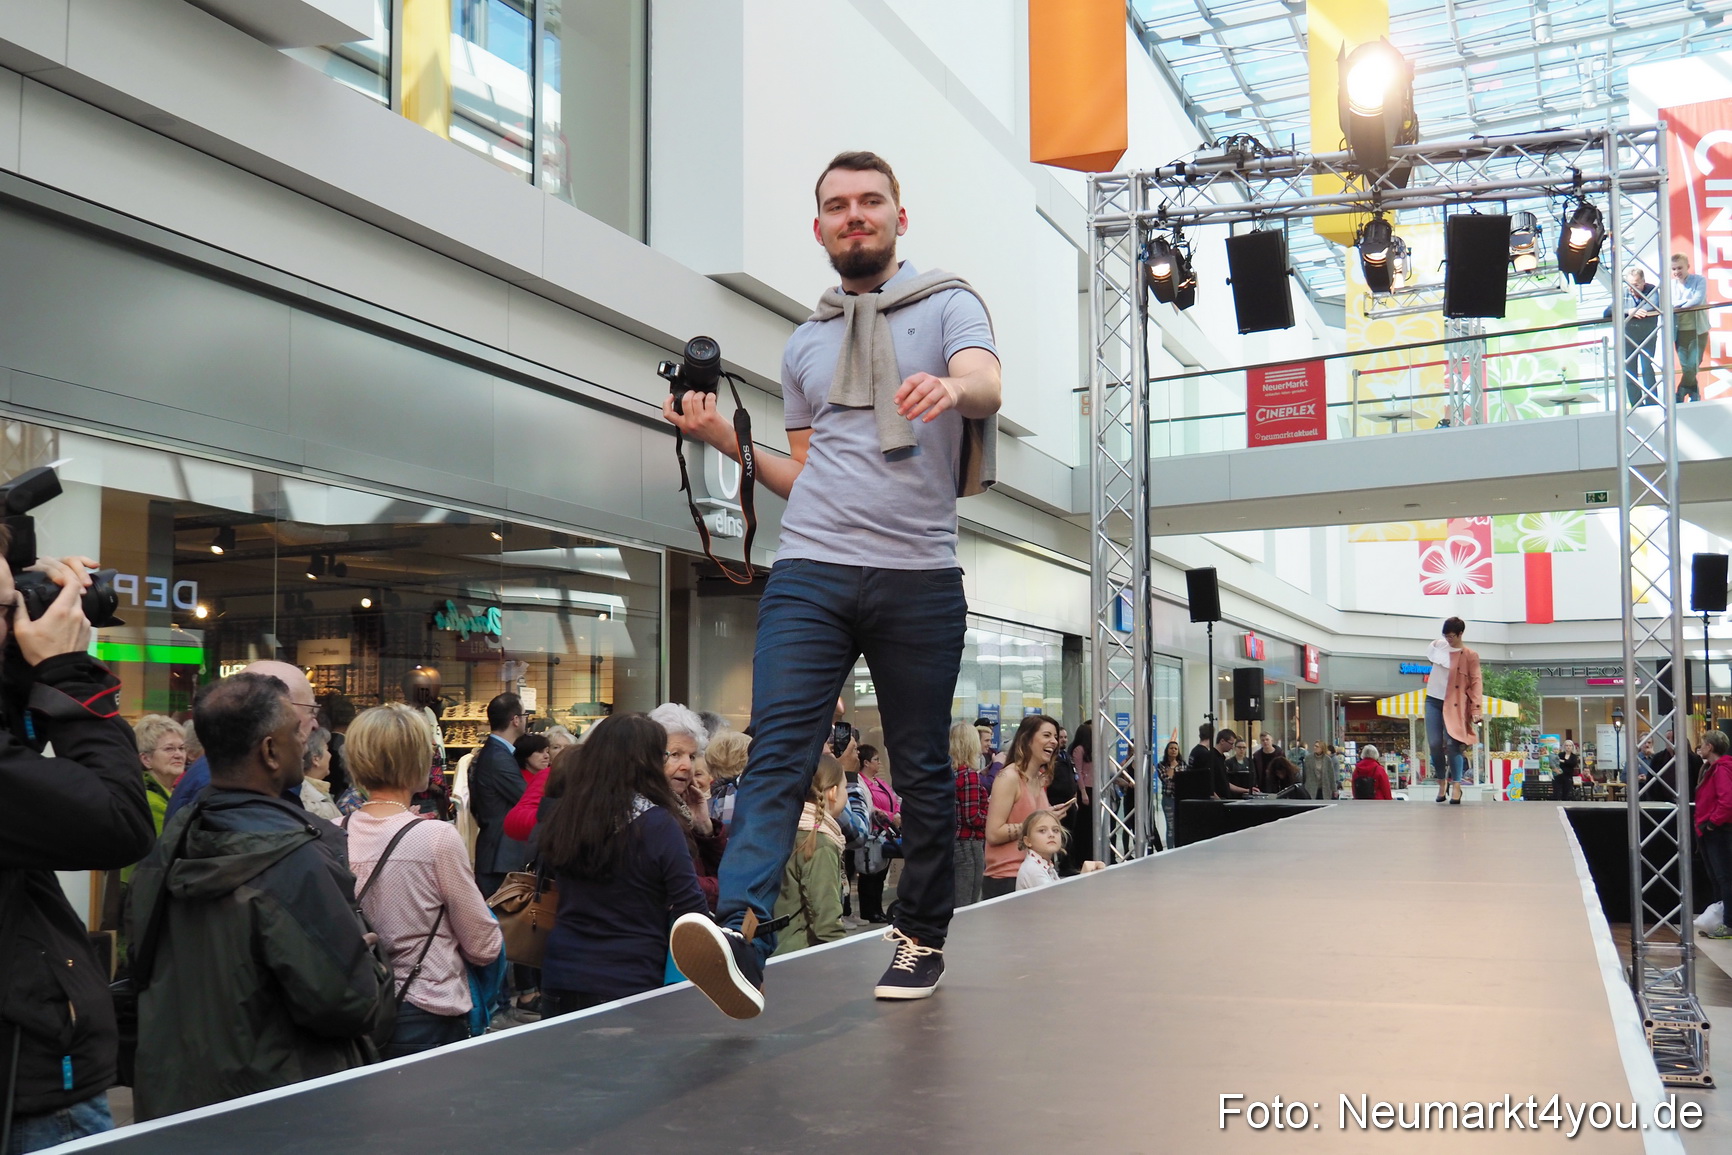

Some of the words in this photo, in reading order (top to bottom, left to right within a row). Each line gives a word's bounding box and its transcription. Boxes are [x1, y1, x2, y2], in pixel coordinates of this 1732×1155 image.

[1262, 380, 1308, 391] NeuerMarkt
[1255, 404, 1315, 421] CINEPLEX
[743, 445, 752, 477] SONY
[1518, 666, 1640, 678] STYLEBO
